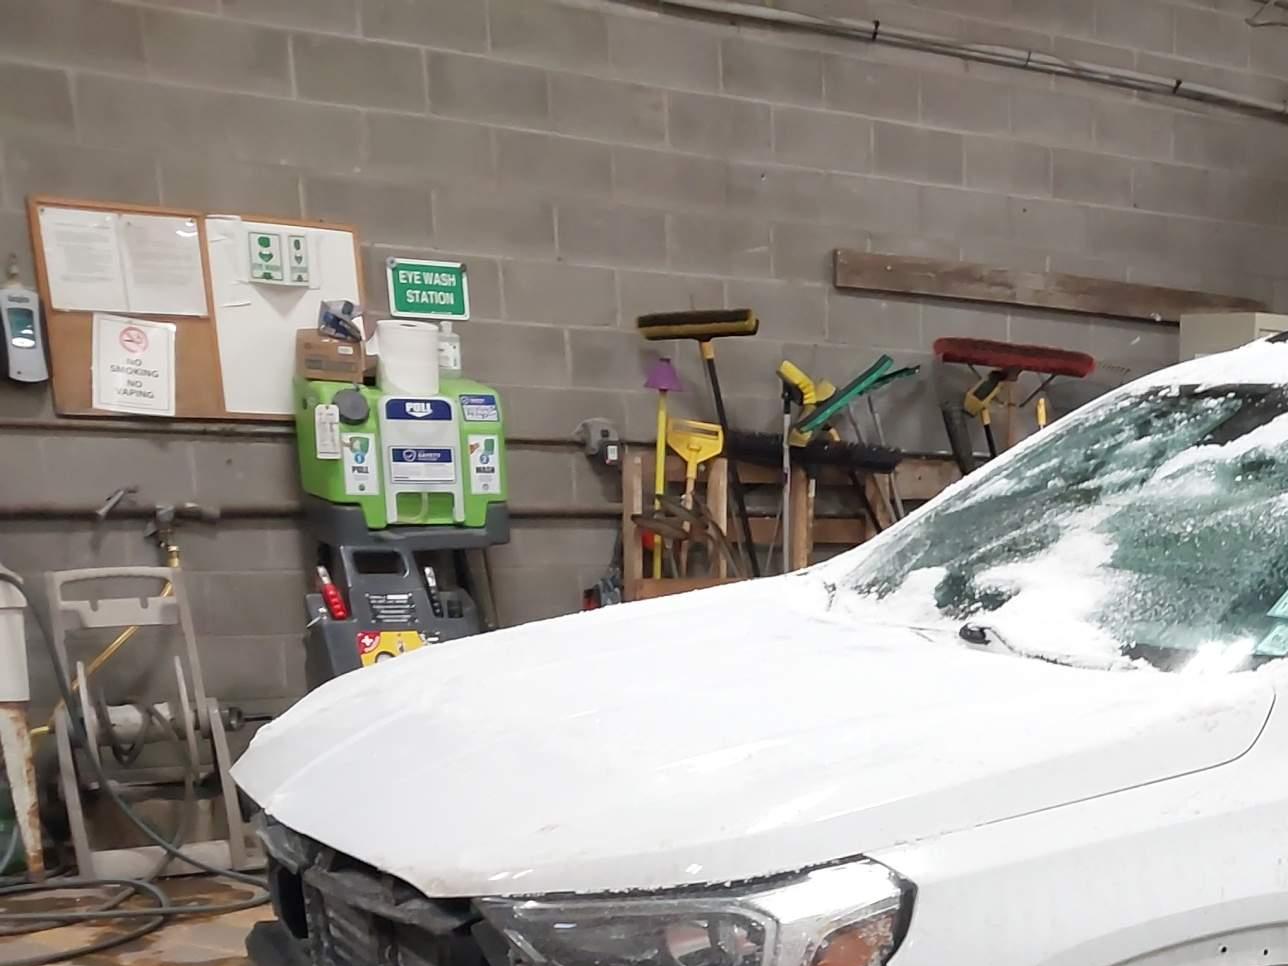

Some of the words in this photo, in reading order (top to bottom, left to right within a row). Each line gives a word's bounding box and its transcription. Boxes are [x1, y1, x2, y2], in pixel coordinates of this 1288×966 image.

[398, 270, 422, 284] EYE
[422, 272, 456, 287] WASH
[406, 289, 454, 304] STATION
[126, 358, 143, 367] NO
[110, 364, 159, 378] SMOKING
[127, 379, 143, 388] NO
[117, 387, 155, 399] VAPING
[405, 402, 431, 413] PULL
